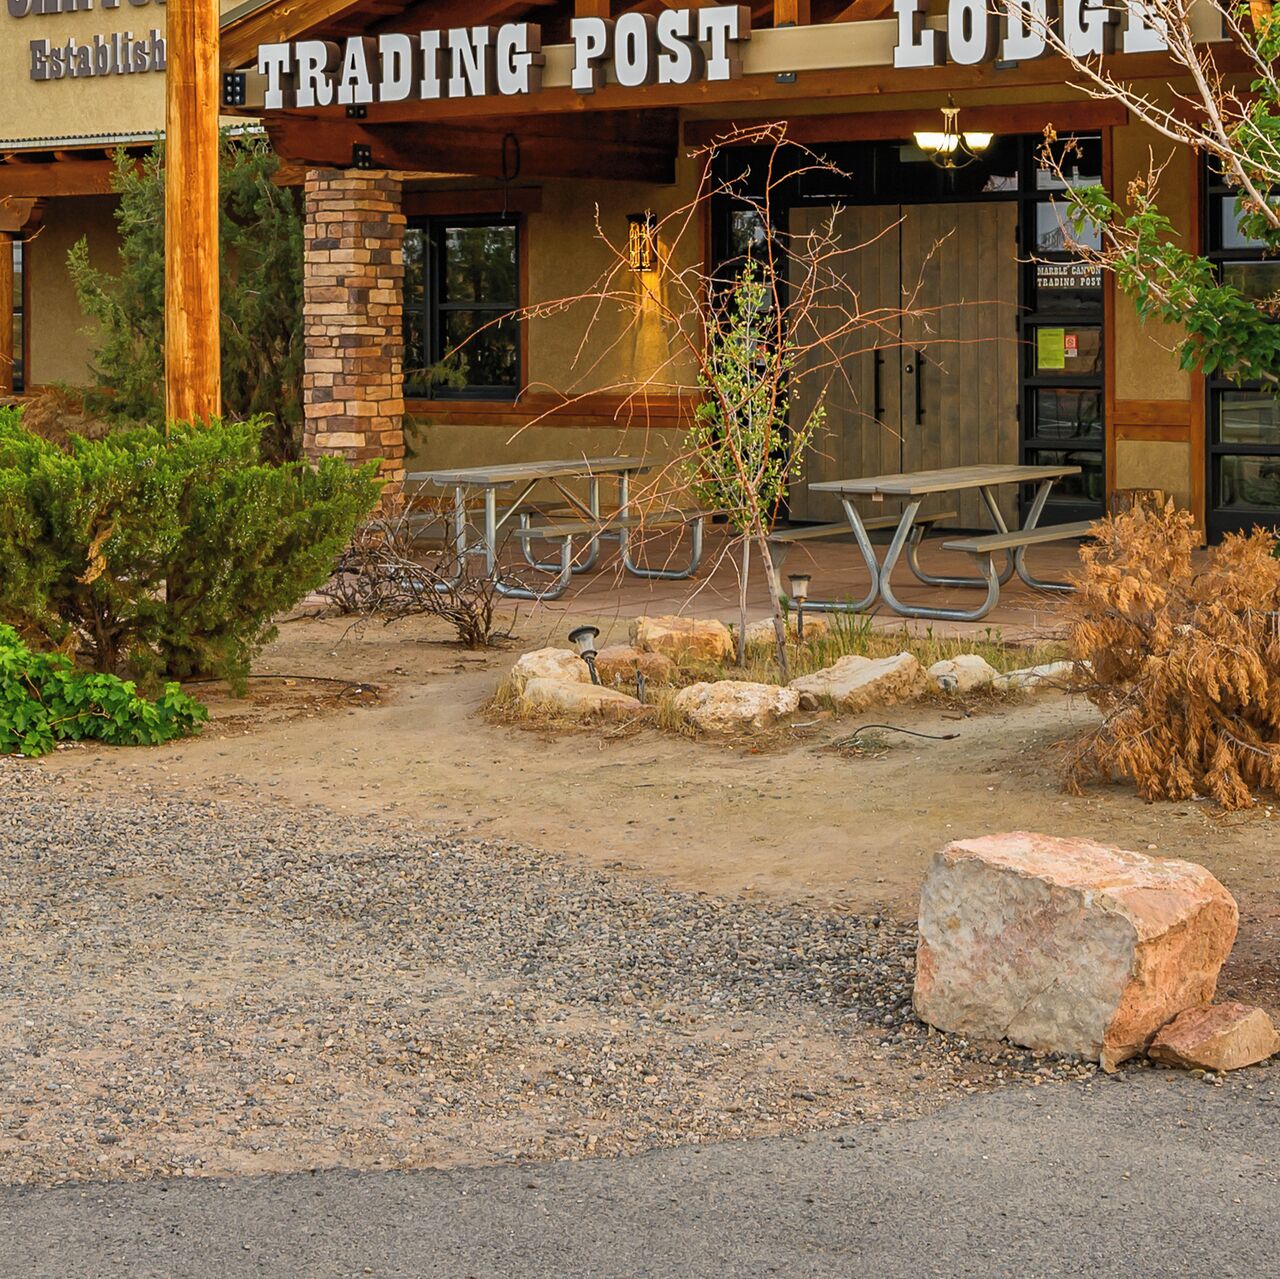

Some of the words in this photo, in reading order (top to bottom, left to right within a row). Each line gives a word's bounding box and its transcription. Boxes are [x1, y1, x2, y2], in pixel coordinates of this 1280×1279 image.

[258, 22, 542, 110] TRADING
[570, 4, 751, 90] POST
[1037, 265, 1068, 276] MARBLE
[1071, 264, 1101, 275] CANYON
[1036, 277, 1075, 287] TRADING
[1080, 276, 1101, 287] POST
